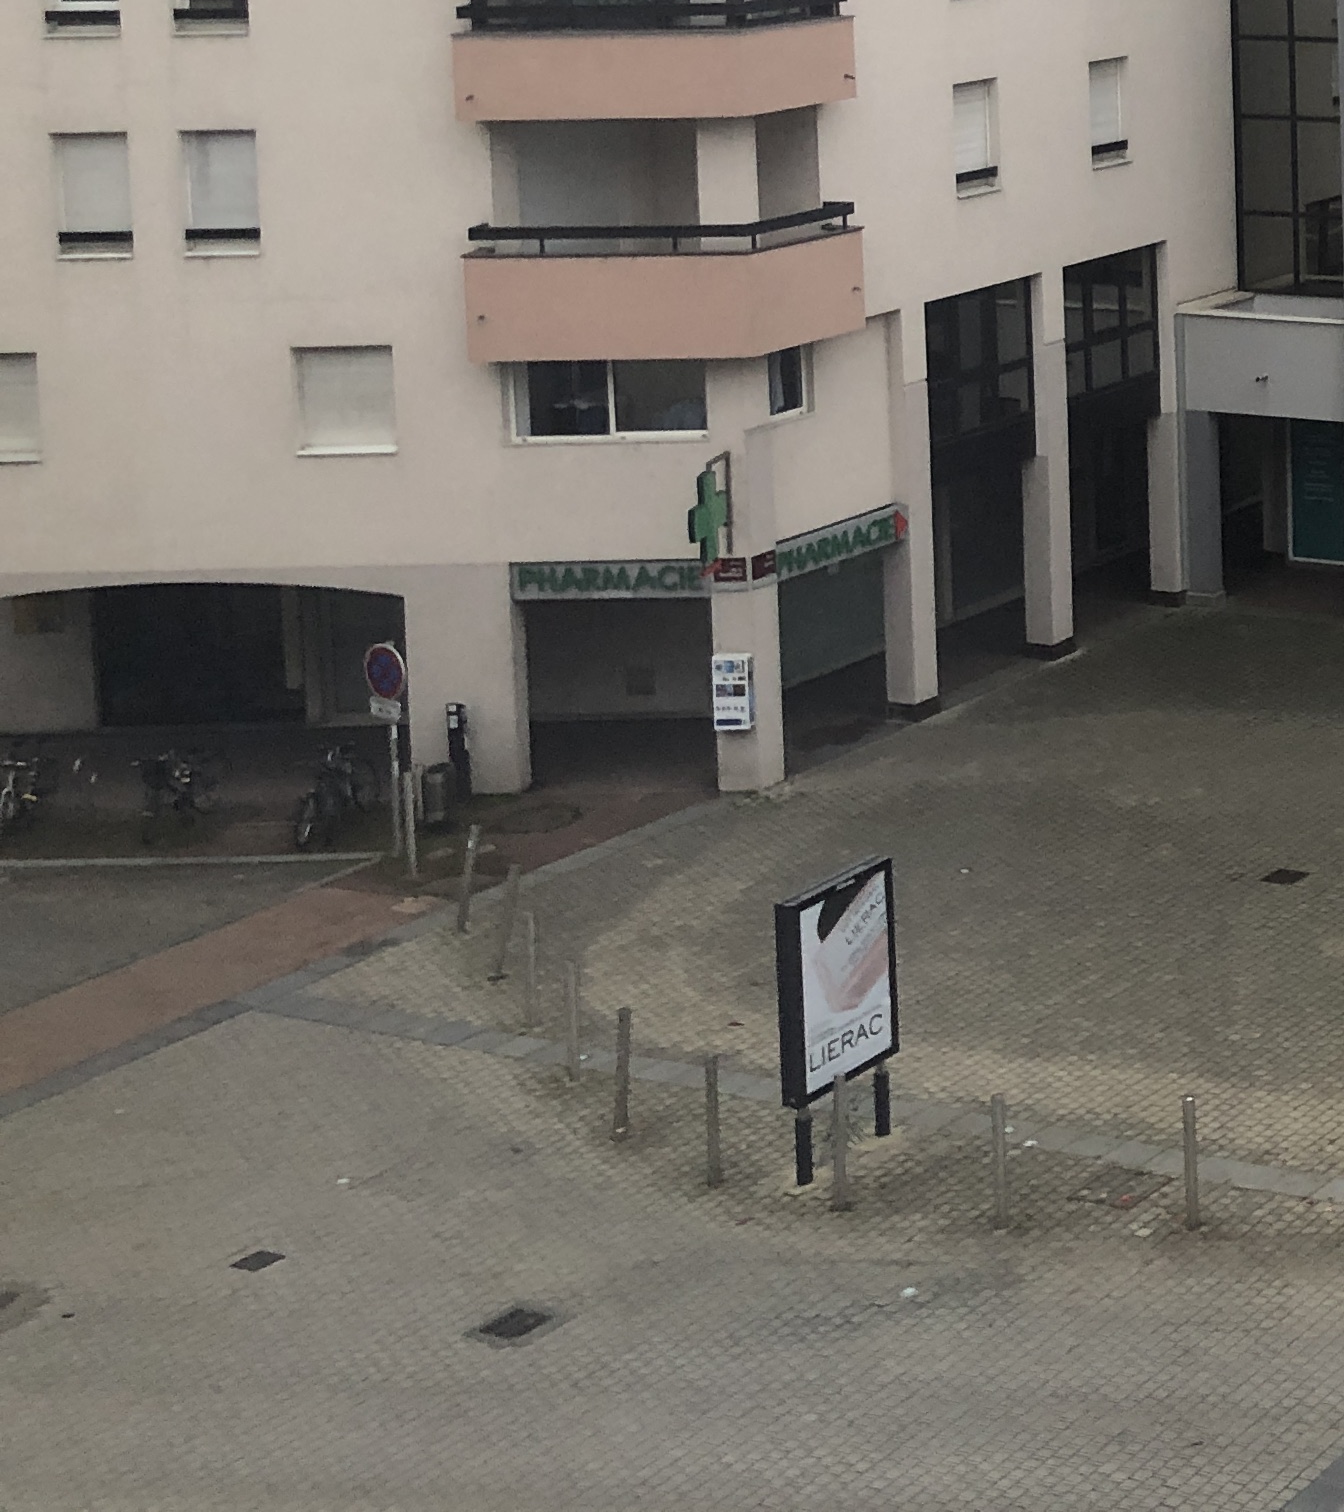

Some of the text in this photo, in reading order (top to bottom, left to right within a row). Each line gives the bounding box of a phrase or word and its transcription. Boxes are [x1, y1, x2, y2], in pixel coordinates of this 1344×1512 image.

[776, 515, 895, 576] PHARMACIE
[517, 564, 705, 592] PHARMACIE
[809, 1013, 883, 1073] LIERAC
